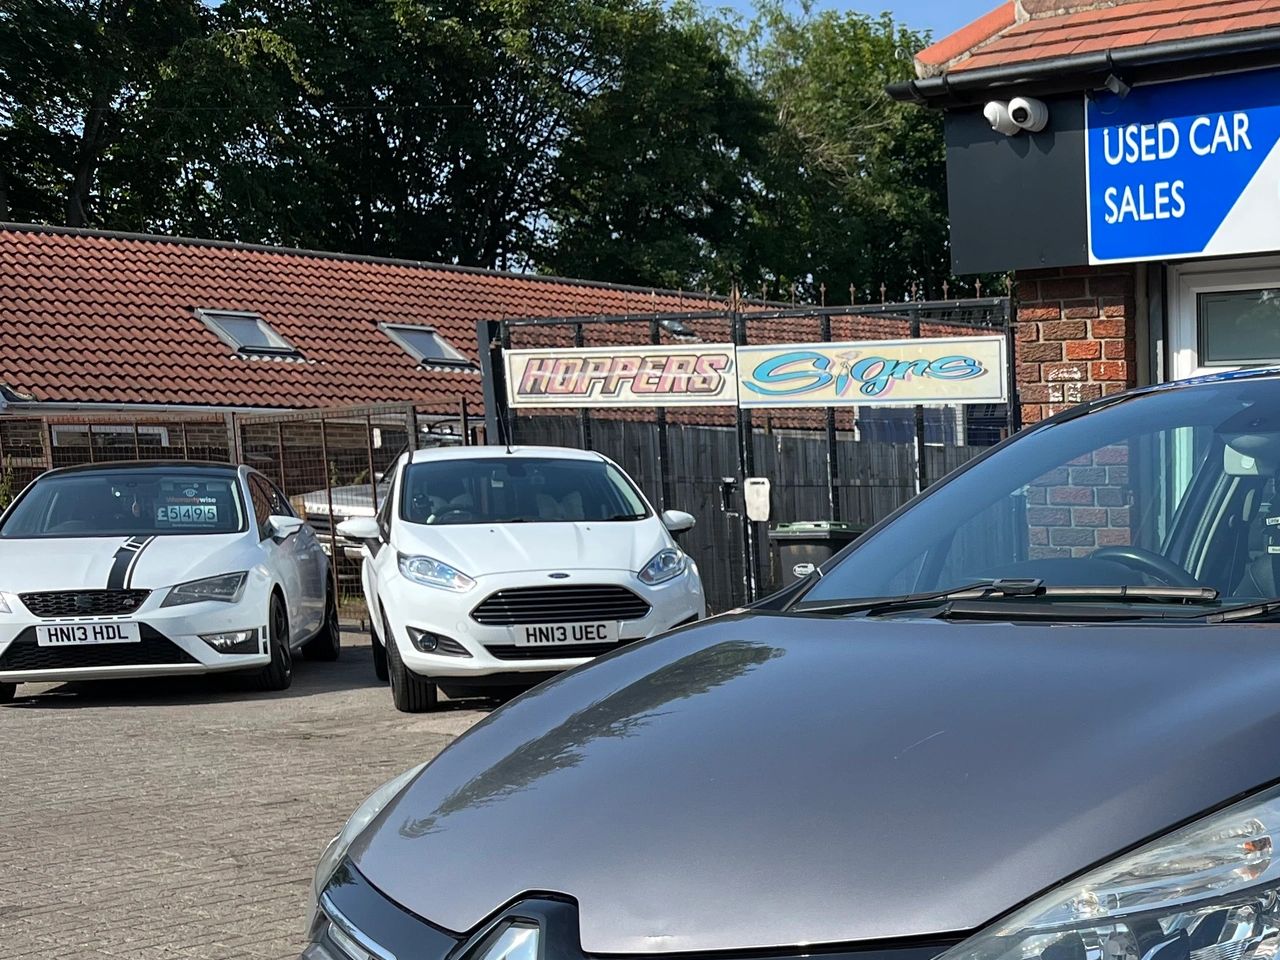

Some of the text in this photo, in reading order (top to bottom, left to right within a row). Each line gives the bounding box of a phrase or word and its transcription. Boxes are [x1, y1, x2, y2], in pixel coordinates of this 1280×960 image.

[1103, 112, 1252, 165] USED CAR
[1104, 180, 1186, 224] SALES
[518, 353, 729, 395] HOPPERS
[741, 350, 984, 396] Signs
[47, 625, 129, 643] HN13 HDL
[525, 624, 607, 643] HN13 UEC
